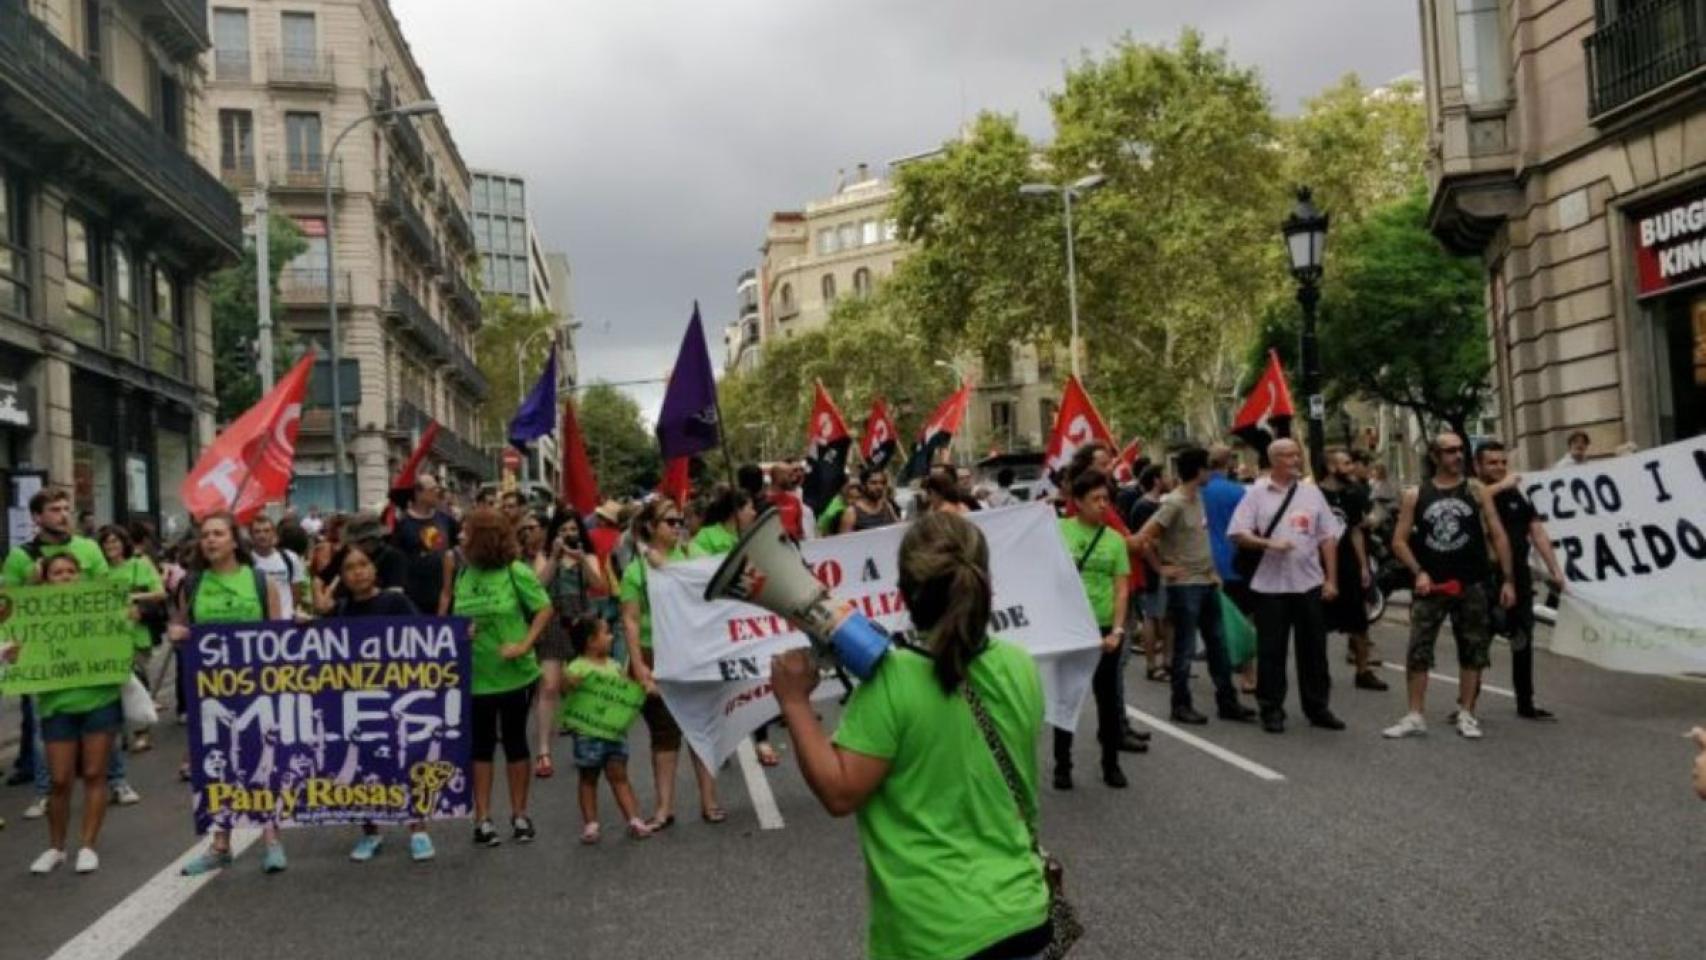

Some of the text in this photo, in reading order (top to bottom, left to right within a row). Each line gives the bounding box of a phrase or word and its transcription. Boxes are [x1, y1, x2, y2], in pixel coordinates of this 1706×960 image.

[1640, 198, 1706, 247] BURG
[1551, 518, 1706, 582] RAÏDO
[806, 557, 881, 590] O A
[198, 625, 457, 666] Si TOCAN a UNA
[719, 604, 1030, 681] EN DE
[197, 661, 460, 697] NOS ORGANIZAMOS
[201, 688, 462, 745] MILES!
[206, 777, 407, 818] Pan y Rosas
